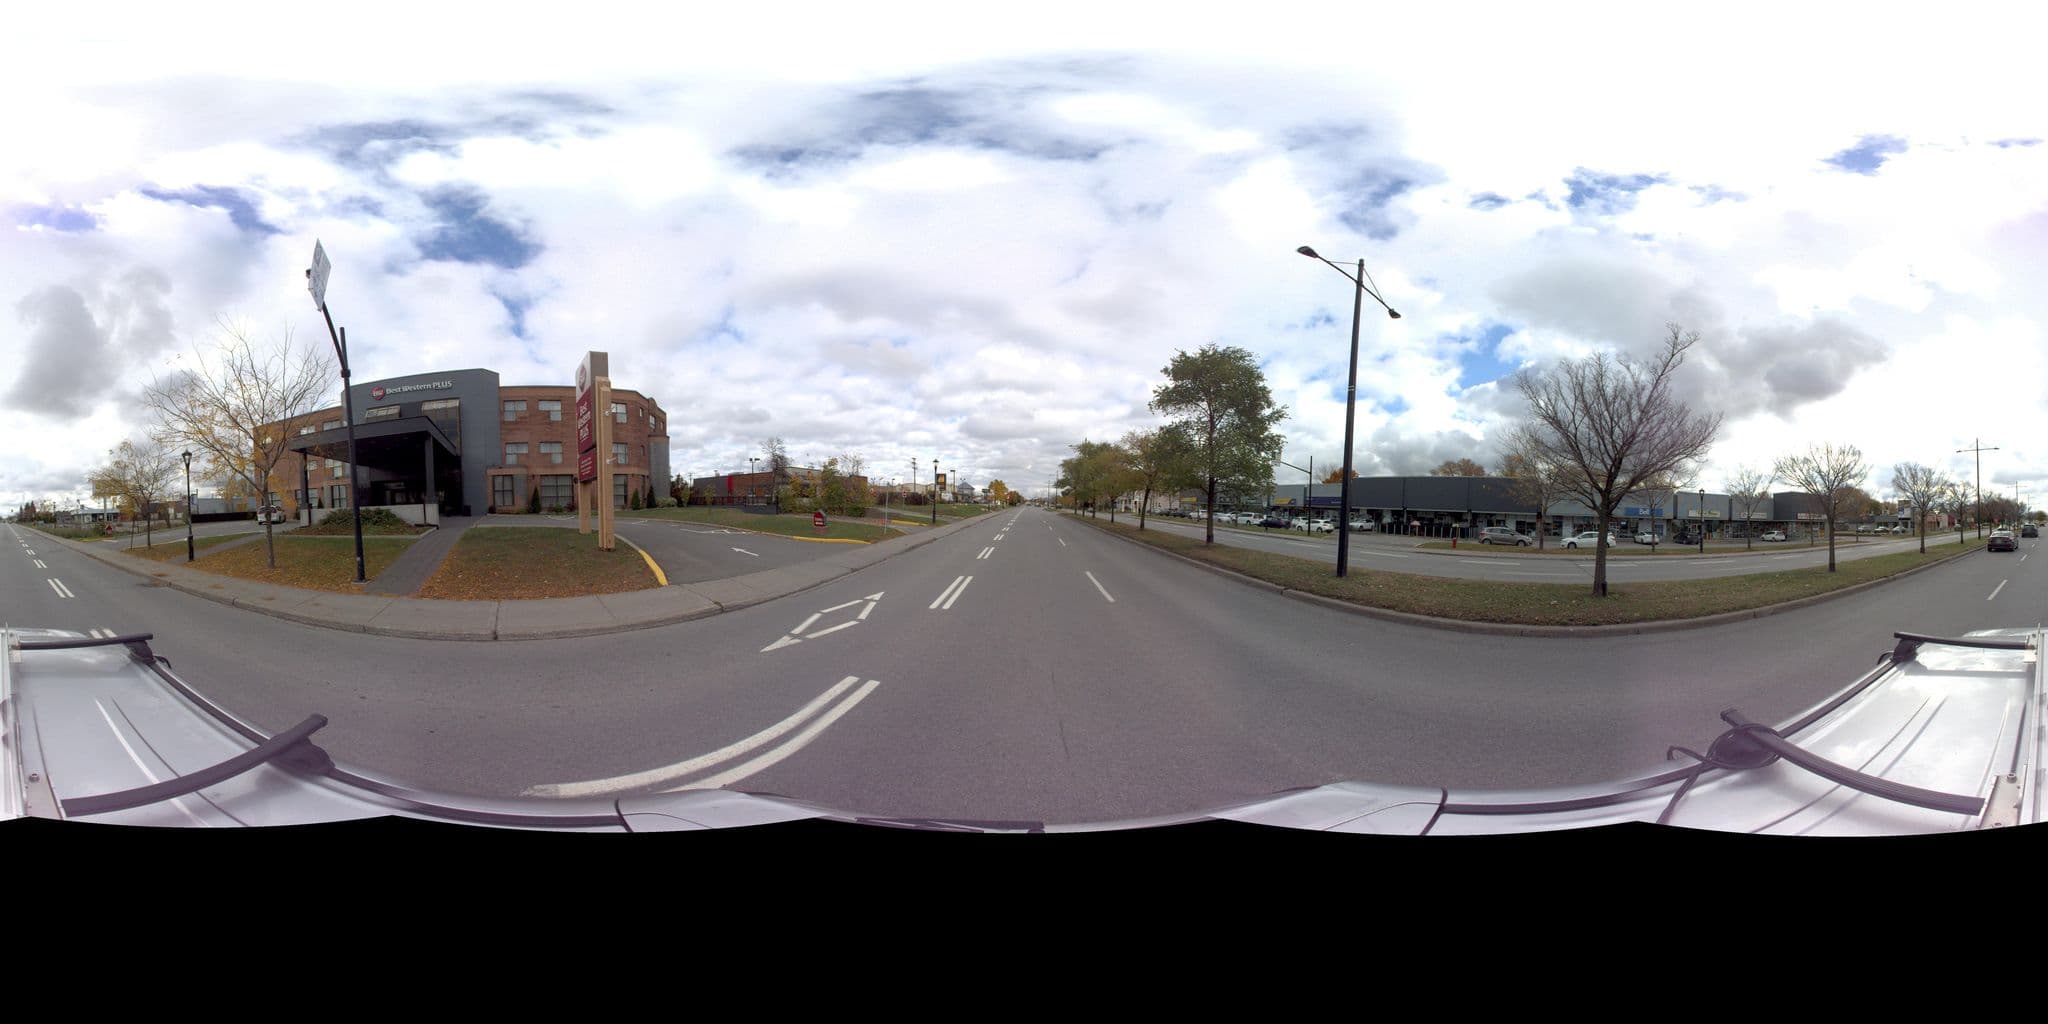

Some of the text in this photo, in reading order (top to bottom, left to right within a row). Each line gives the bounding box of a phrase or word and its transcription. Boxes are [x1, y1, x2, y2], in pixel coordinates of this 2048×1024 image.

[386, 380, 452, 395] Best Western PLUS
